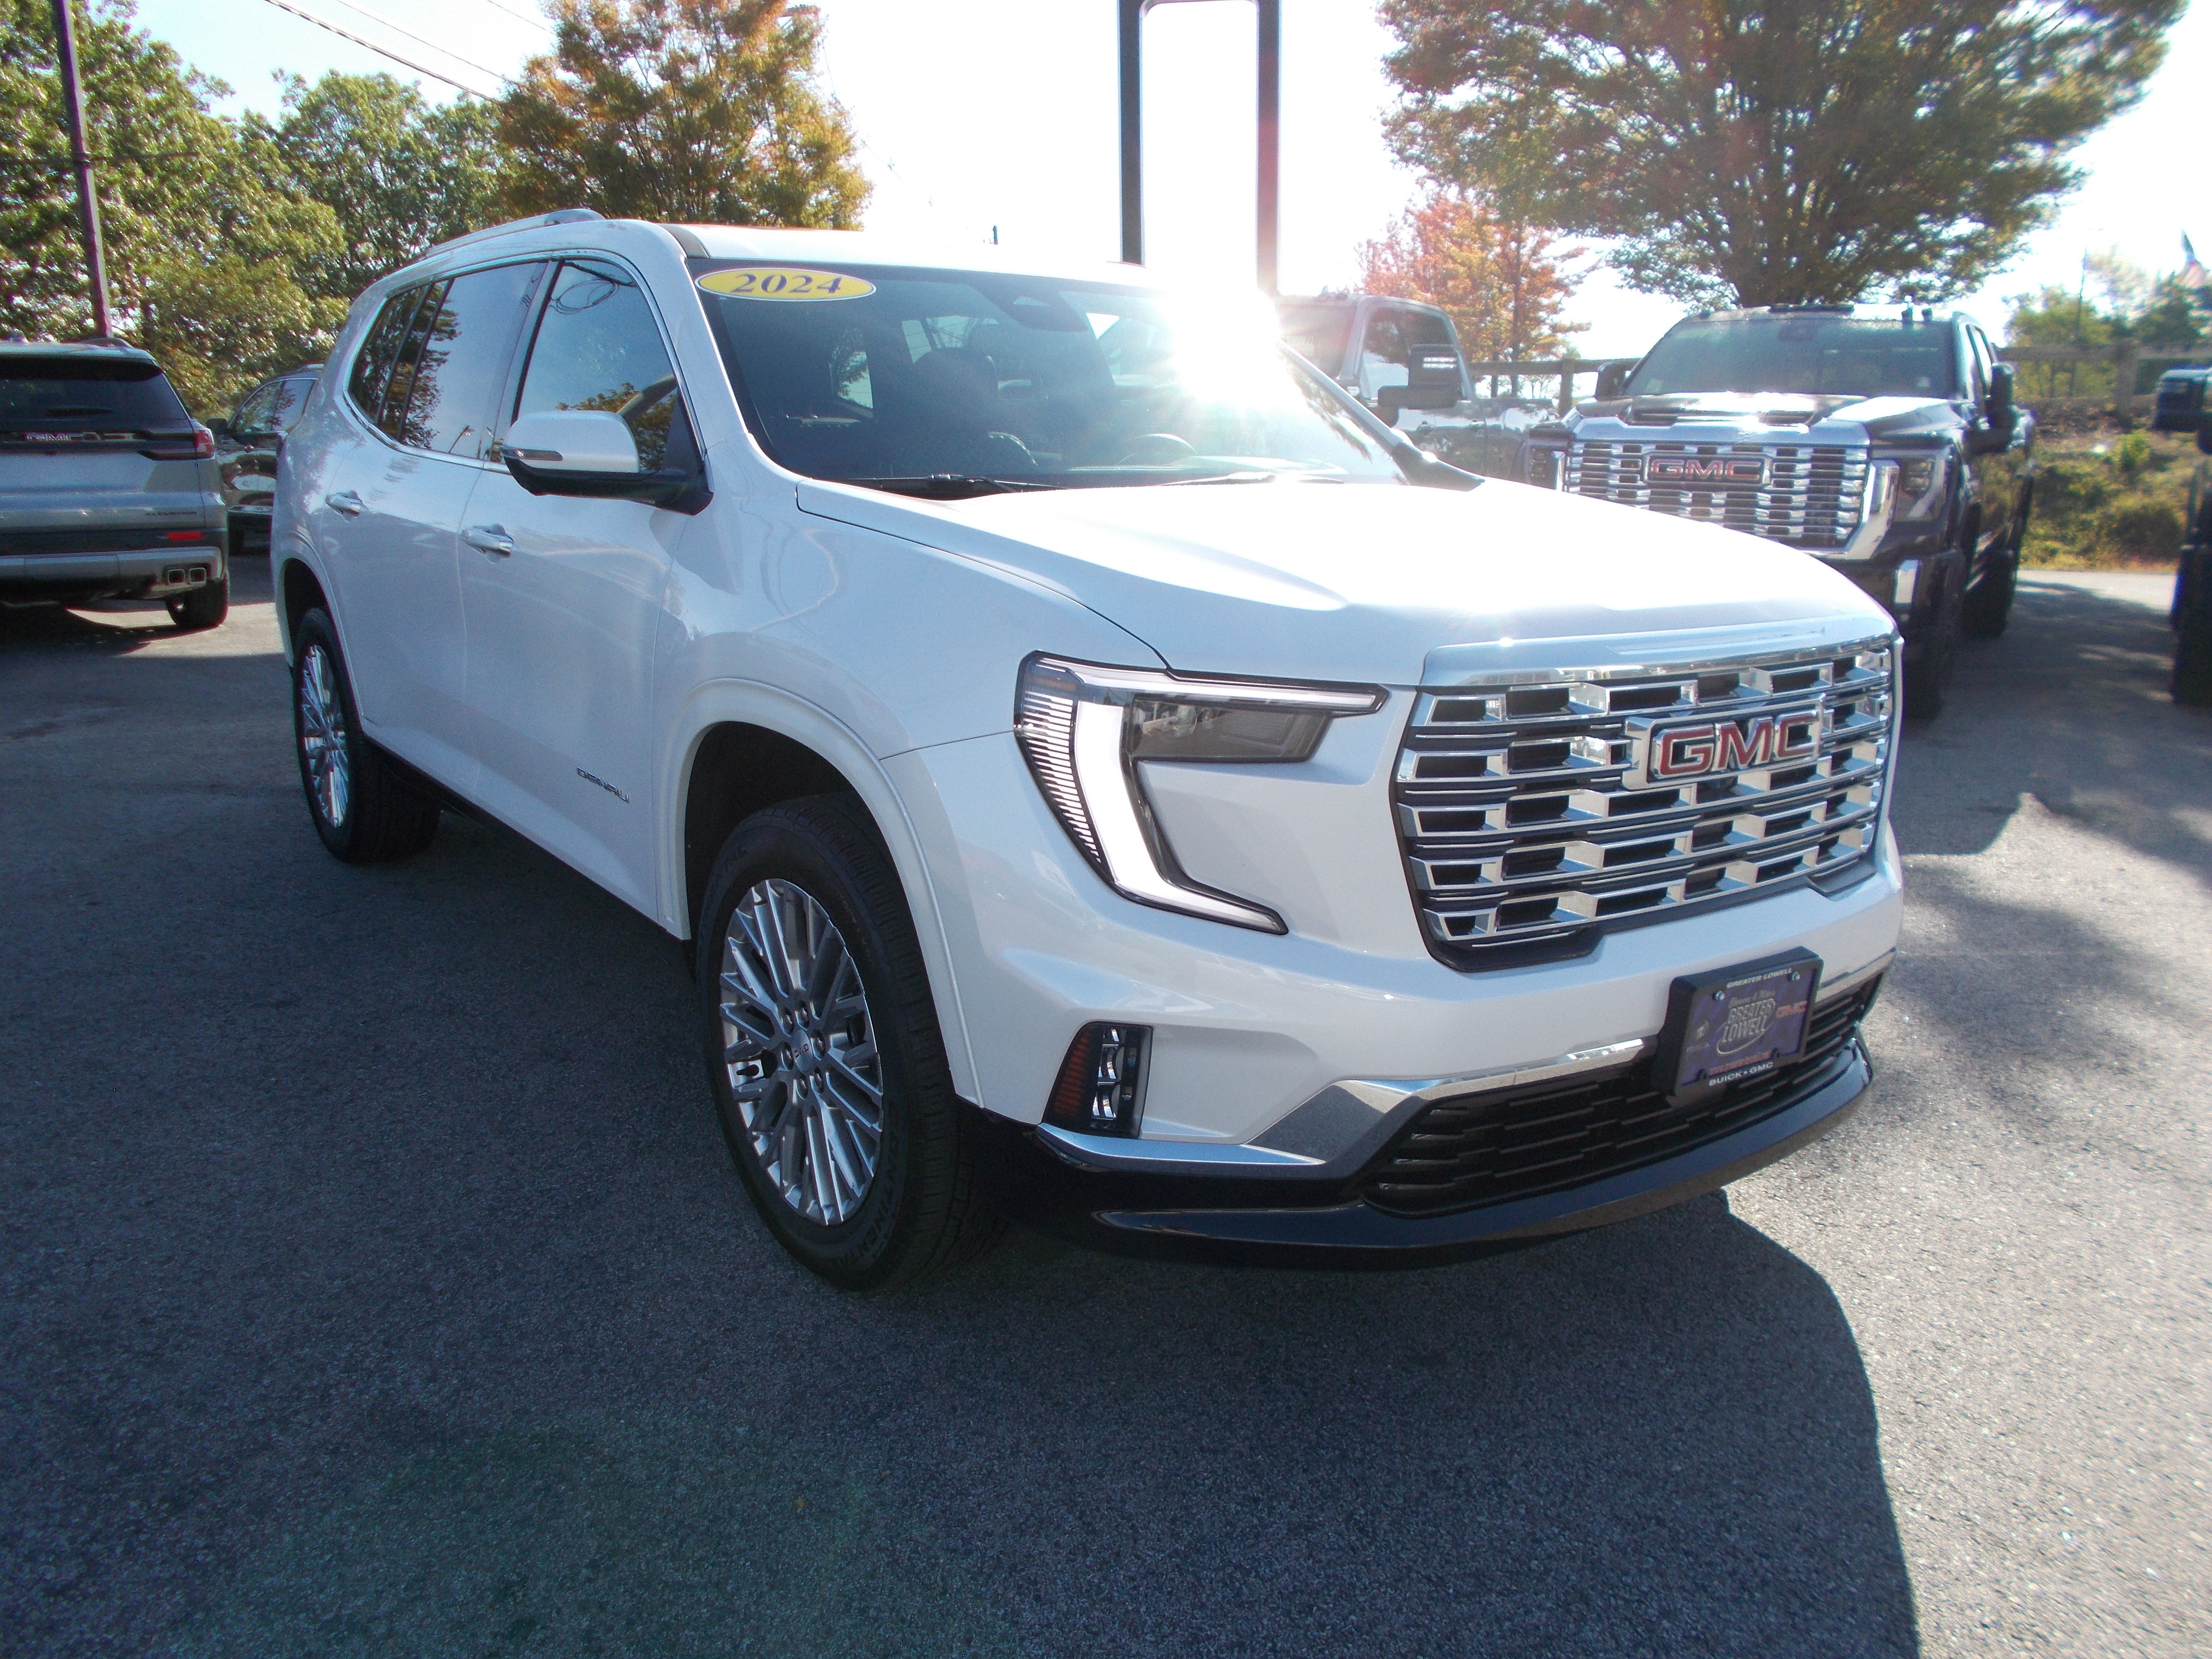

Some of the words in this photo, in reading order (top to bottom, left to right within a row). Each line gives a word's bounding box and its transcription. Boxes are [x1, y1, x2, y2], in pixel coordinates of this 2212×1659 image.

[730, 273, 842, 294] 2024
[1651, 459, 1761, 481] GMC
[1652, 709, 1818, 779] GMC
[1727, 975, 1762, 988] GREATER
[1763, 968, 1792, 980] LOWELL
[1722, 1015, 1767, 1043] LOWELL
[1709, 1070, 1742, 1086] BUICK
[1750, 1061, 1774, 1074] GMC
